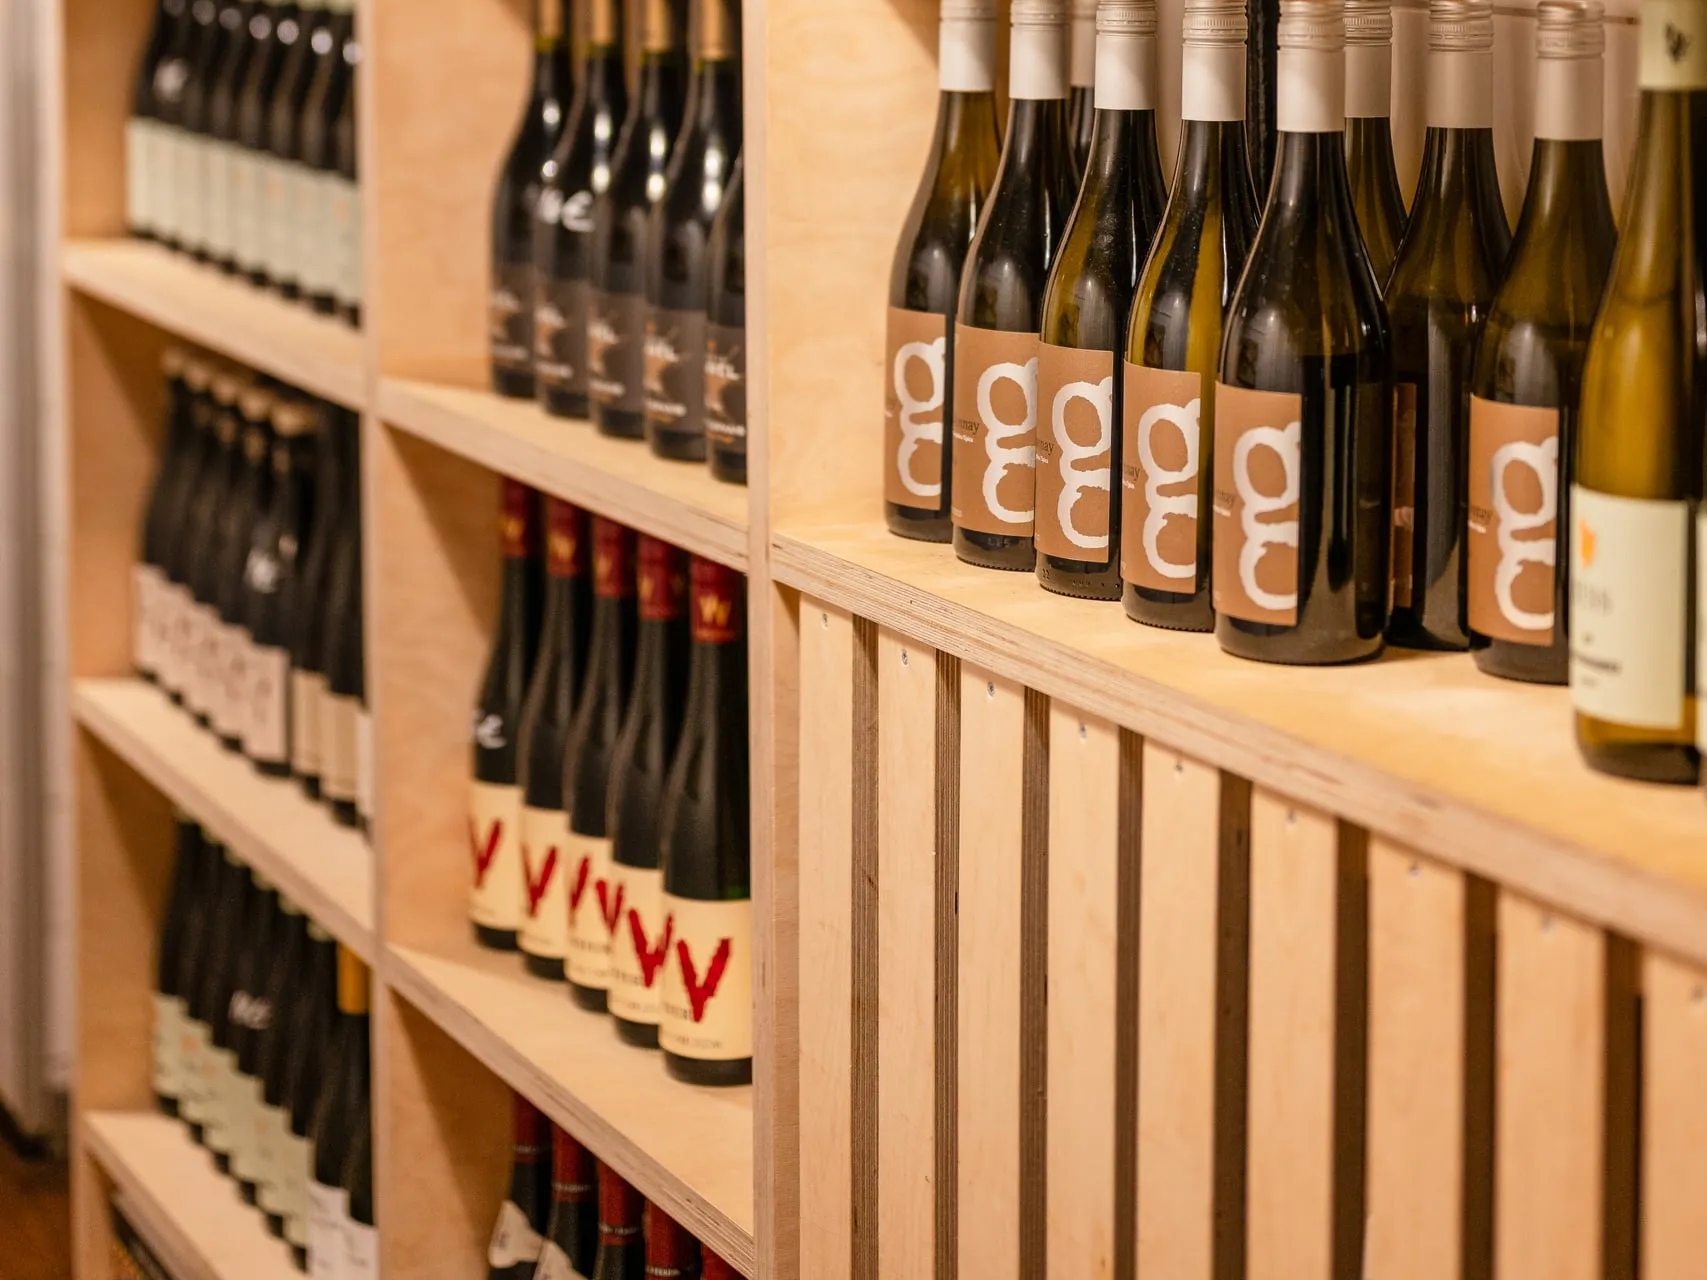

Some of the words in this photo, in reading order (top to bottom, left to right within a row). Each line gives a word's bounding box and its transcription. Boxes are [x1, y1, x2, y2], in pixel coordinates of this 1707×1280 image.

[894, 336, 946, 497] g
[977, 357, 1037, 523] g
[1052, 376, 1113, 549] g
[1138, 398, 1201, 578] g
[1233, 421, 1302, 610] g
[1490, 436, 1558, 630] g
